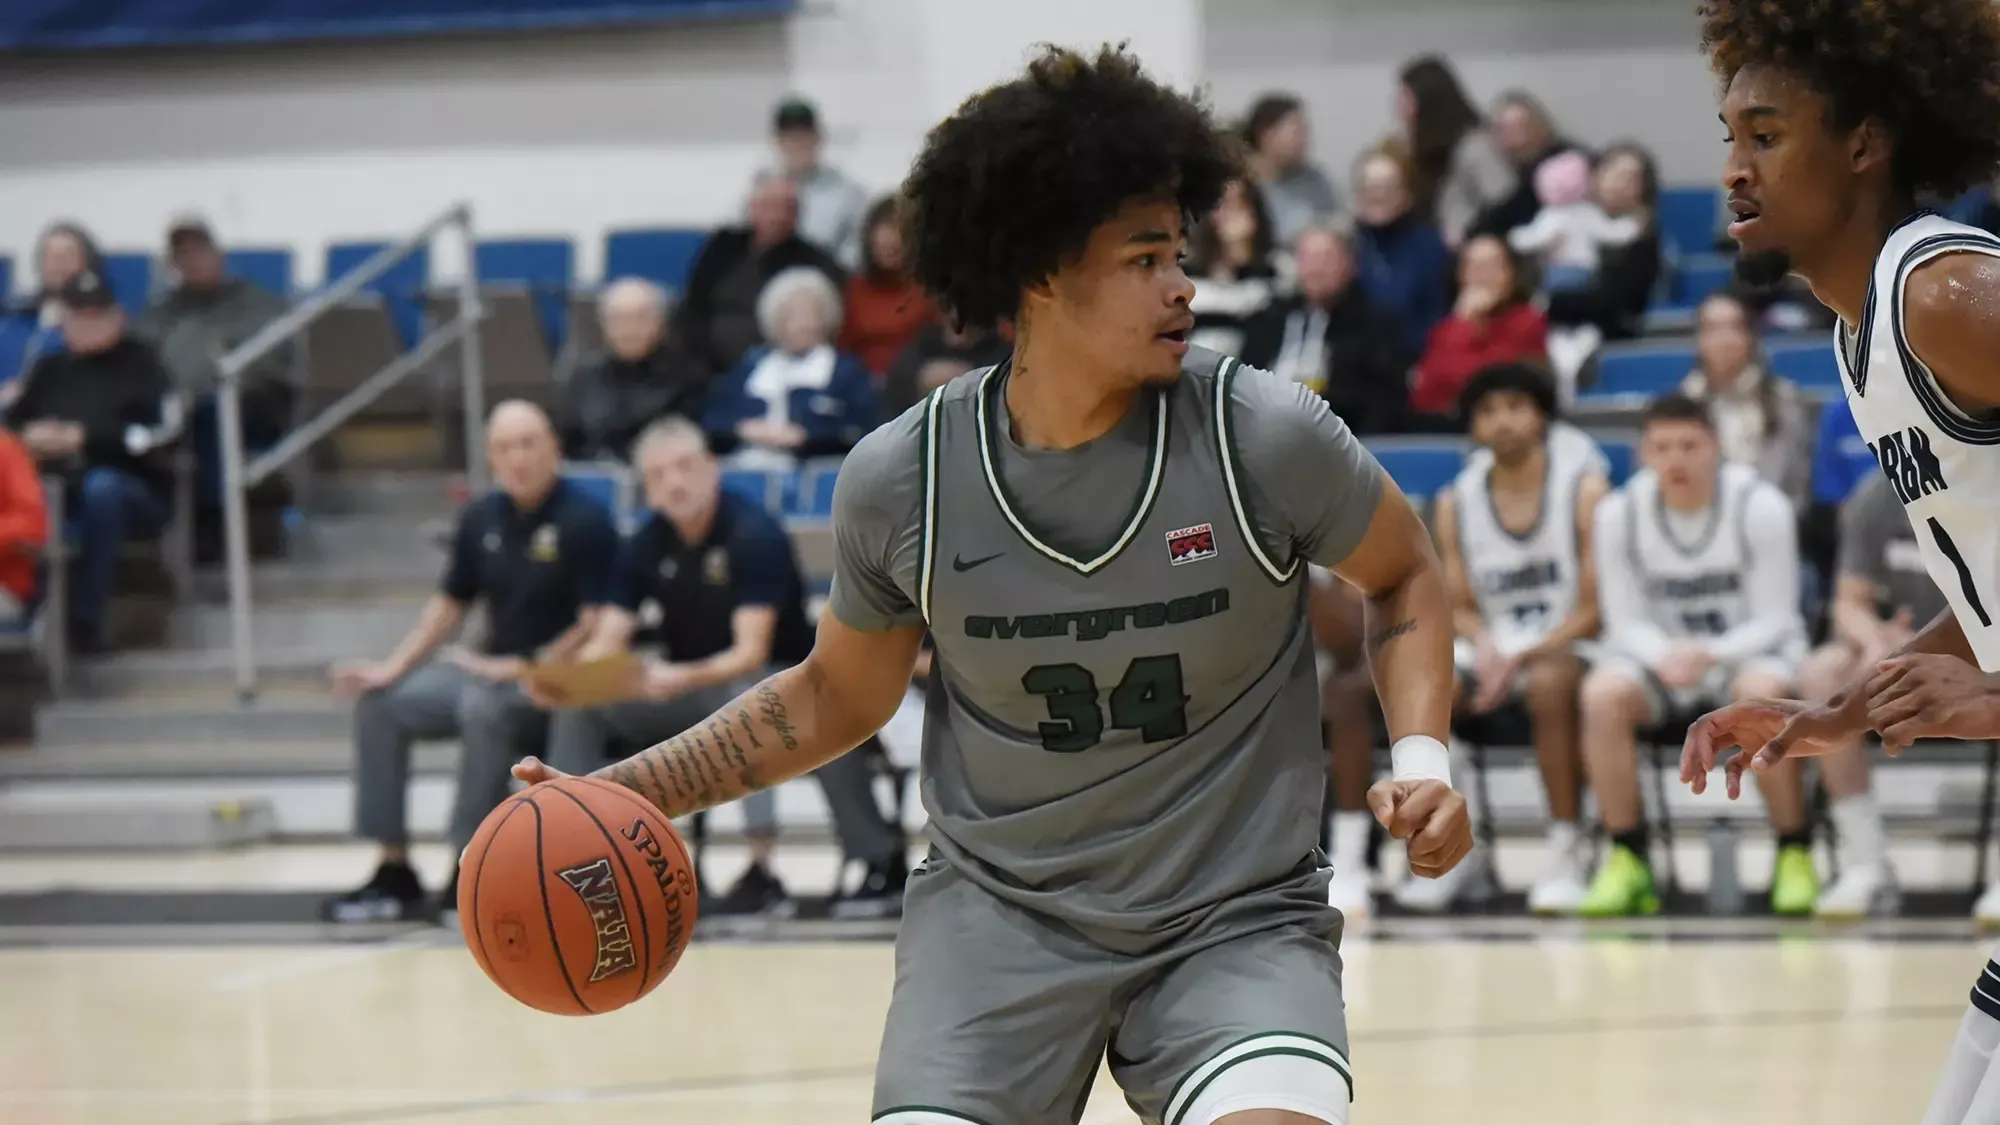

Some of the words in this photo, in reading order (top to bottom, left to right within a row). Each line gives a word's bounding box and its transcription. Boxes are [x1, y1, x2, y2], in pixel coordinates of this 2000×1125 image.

[1167, 524, 1210, 539] CASCADE
[1926, 516, 1993, 628] 1
[964, 587, 1230, 641] evergreen
[1021, 652, 1191, 753] 34
[558, 857, 637, 983] NAIA
